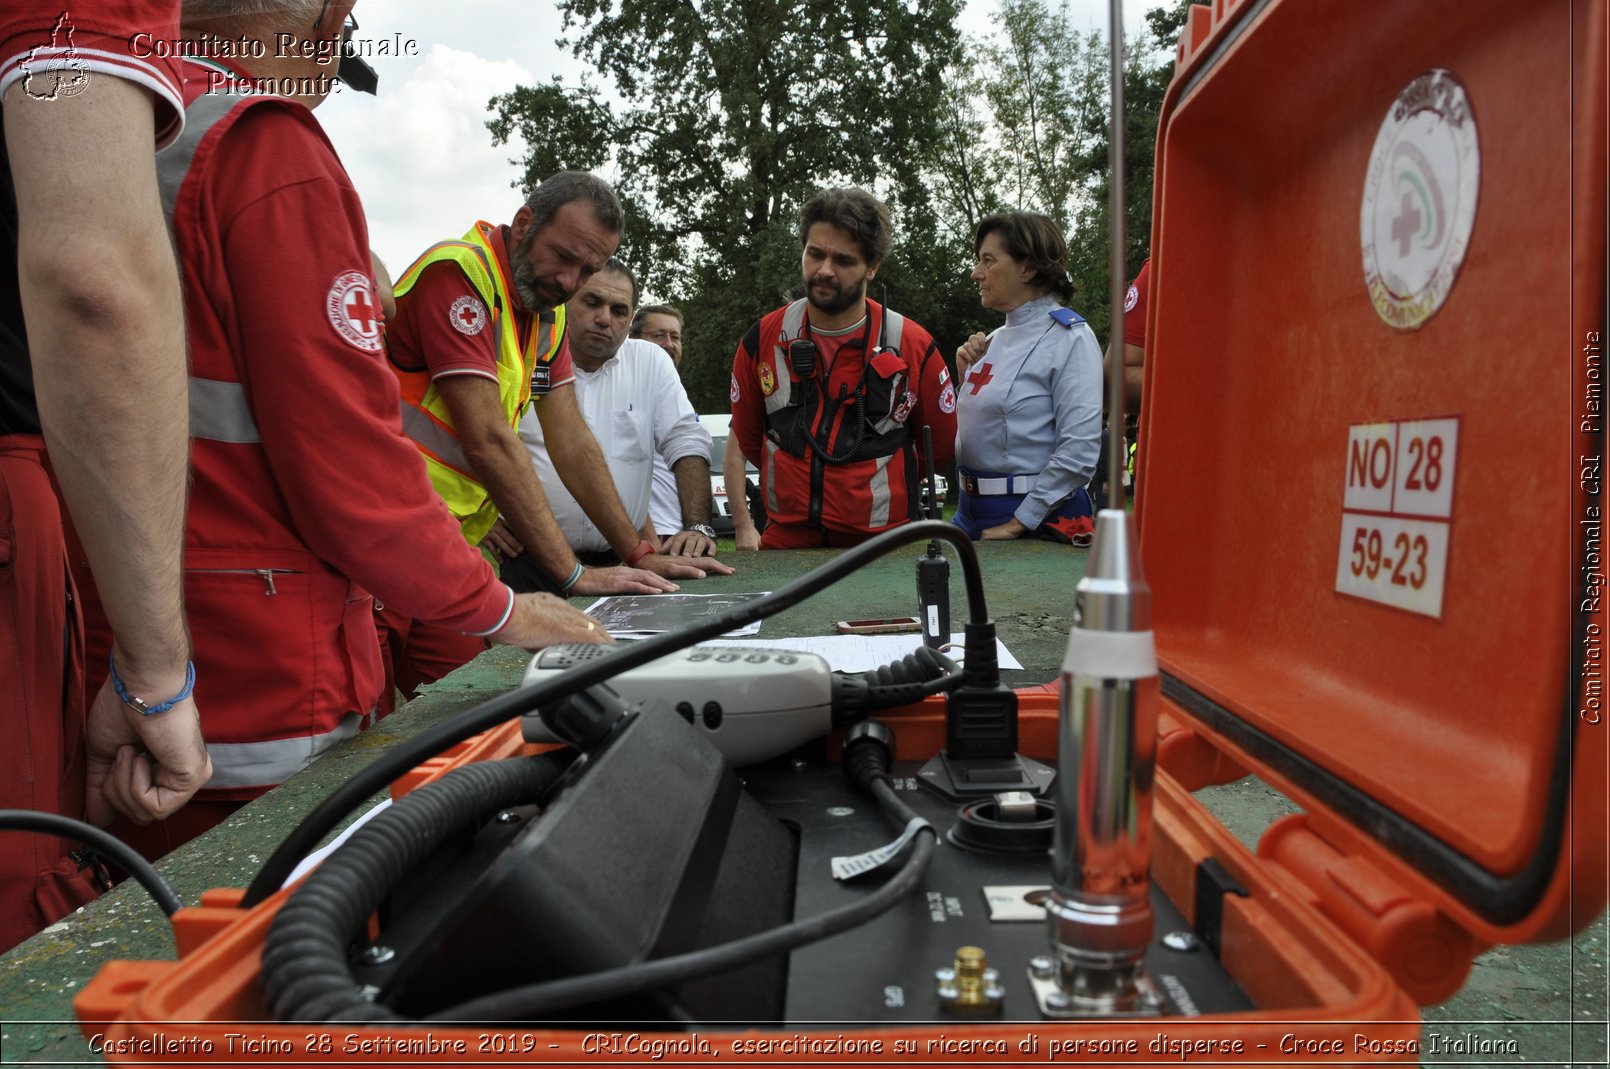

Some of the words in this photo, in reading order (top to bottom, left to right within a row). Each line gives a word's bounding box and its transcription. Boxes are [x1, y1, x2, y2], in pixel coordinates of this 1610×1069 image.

[1349, 437, 1392, 490] NO
[1404, 435, 1444, 492] 28
[1350, 526, 1429, 591] 59-23
